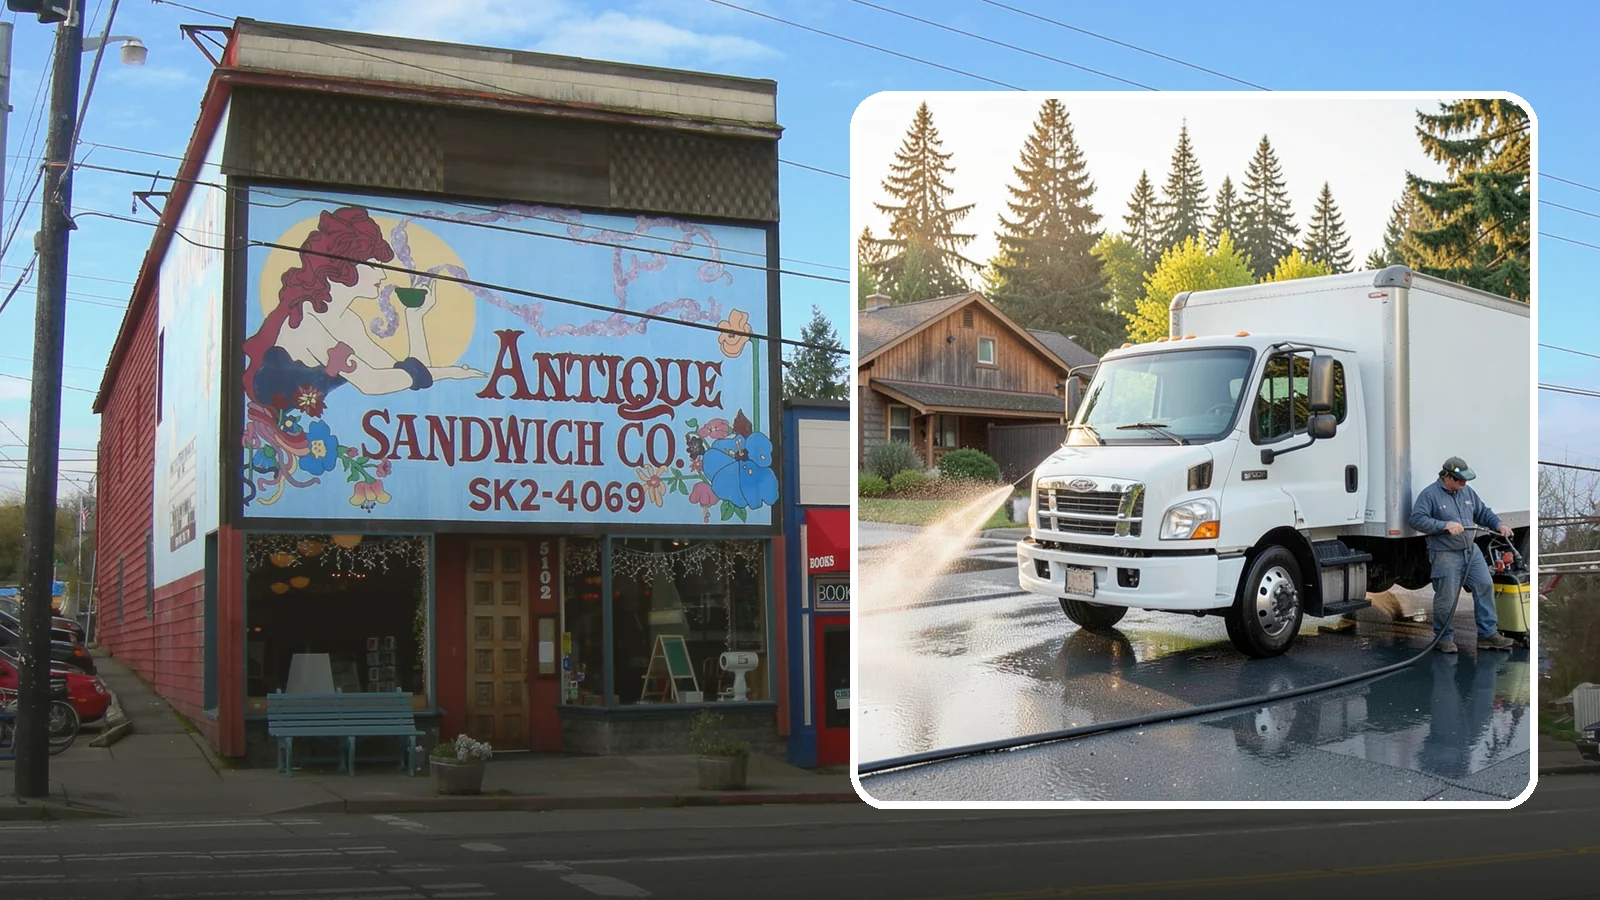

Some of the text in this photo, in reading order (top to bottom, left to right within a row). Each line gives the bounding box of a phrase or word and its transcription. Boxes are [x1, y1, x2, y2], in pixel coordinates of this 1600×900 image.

[476, 329, 723, 420] ANTIQUE
[362, 409, 684, 469] SANDWICH CO.
[469, 478, 645, 512] SK2-4069
[539, 541, 552, 600] 5102
[809, 555, 834, 568] BOOKS
